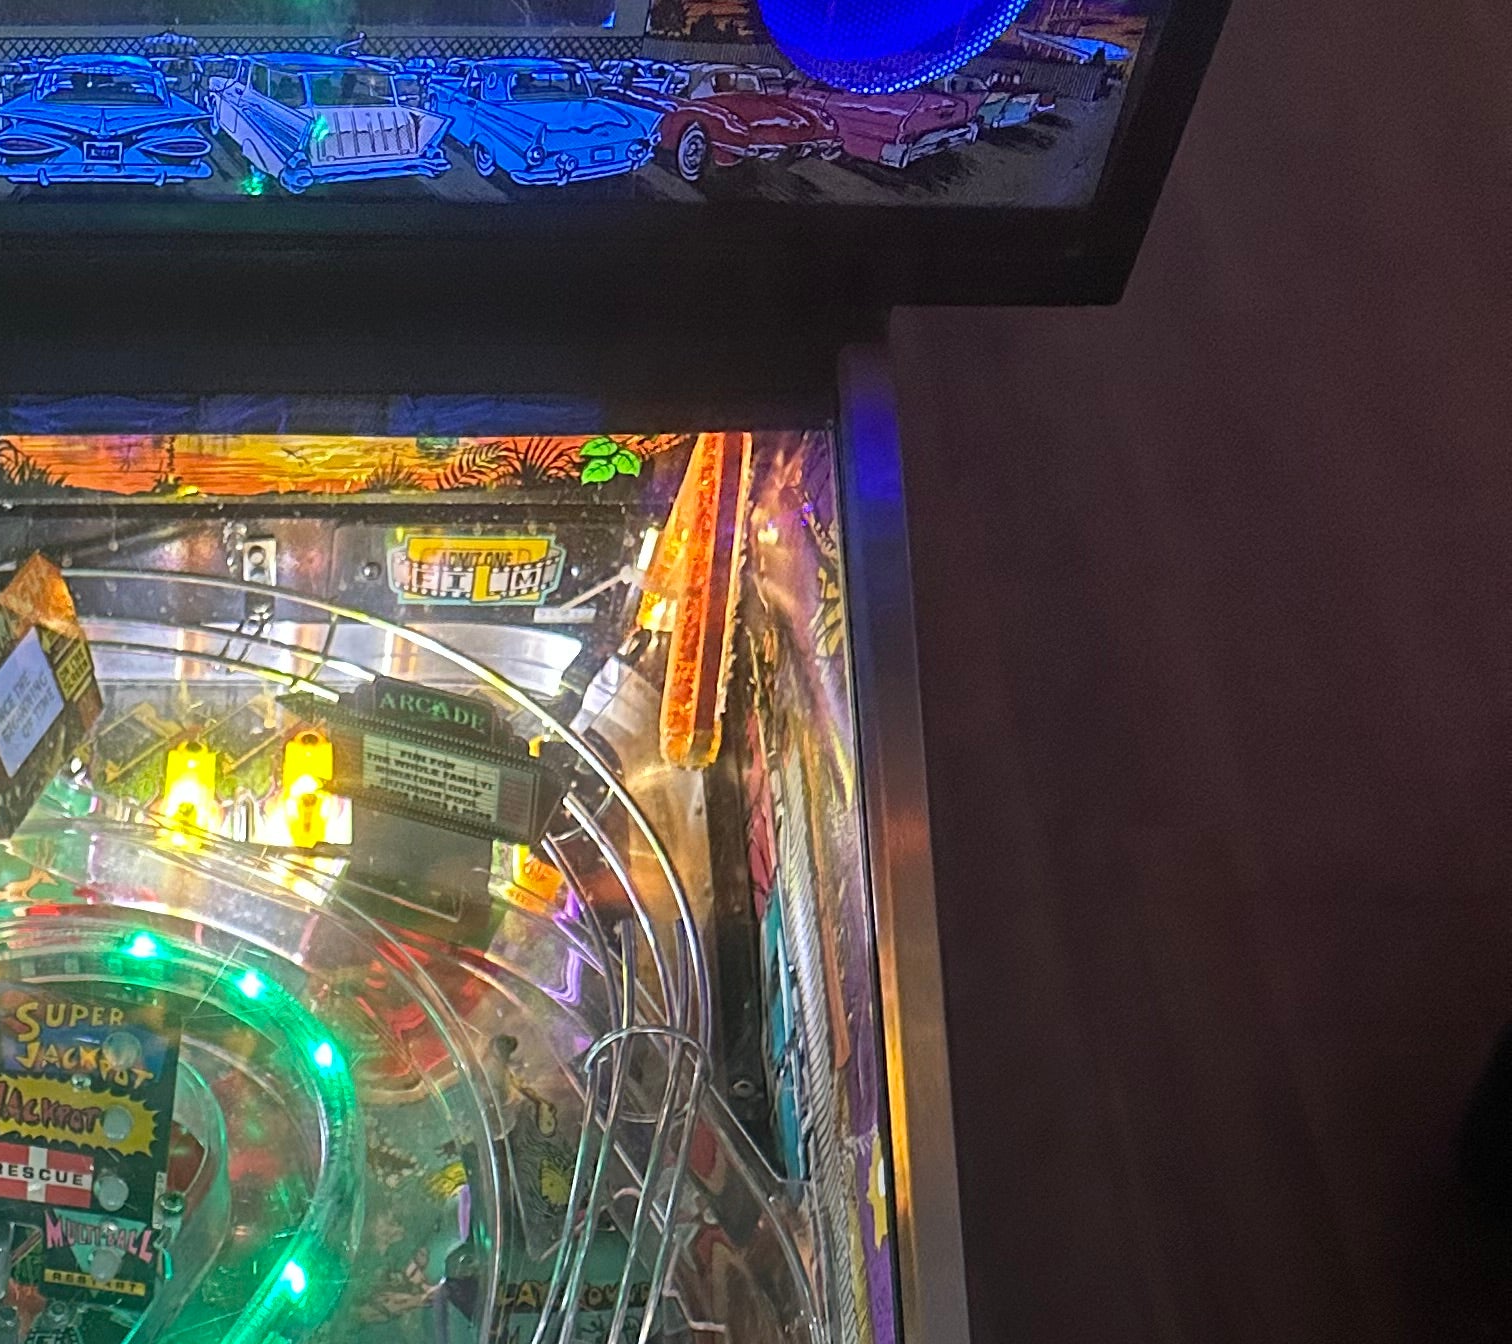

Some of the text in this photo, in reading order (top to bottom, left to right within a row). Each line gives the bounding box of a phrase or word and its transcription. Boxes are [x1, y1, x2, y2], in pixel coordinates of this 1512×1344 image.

[379, 692, 487, 734] ARCADE
[15, 1000, 125, 1043] SUPER
[15, 1040, 155, 1090] JACKPOT
